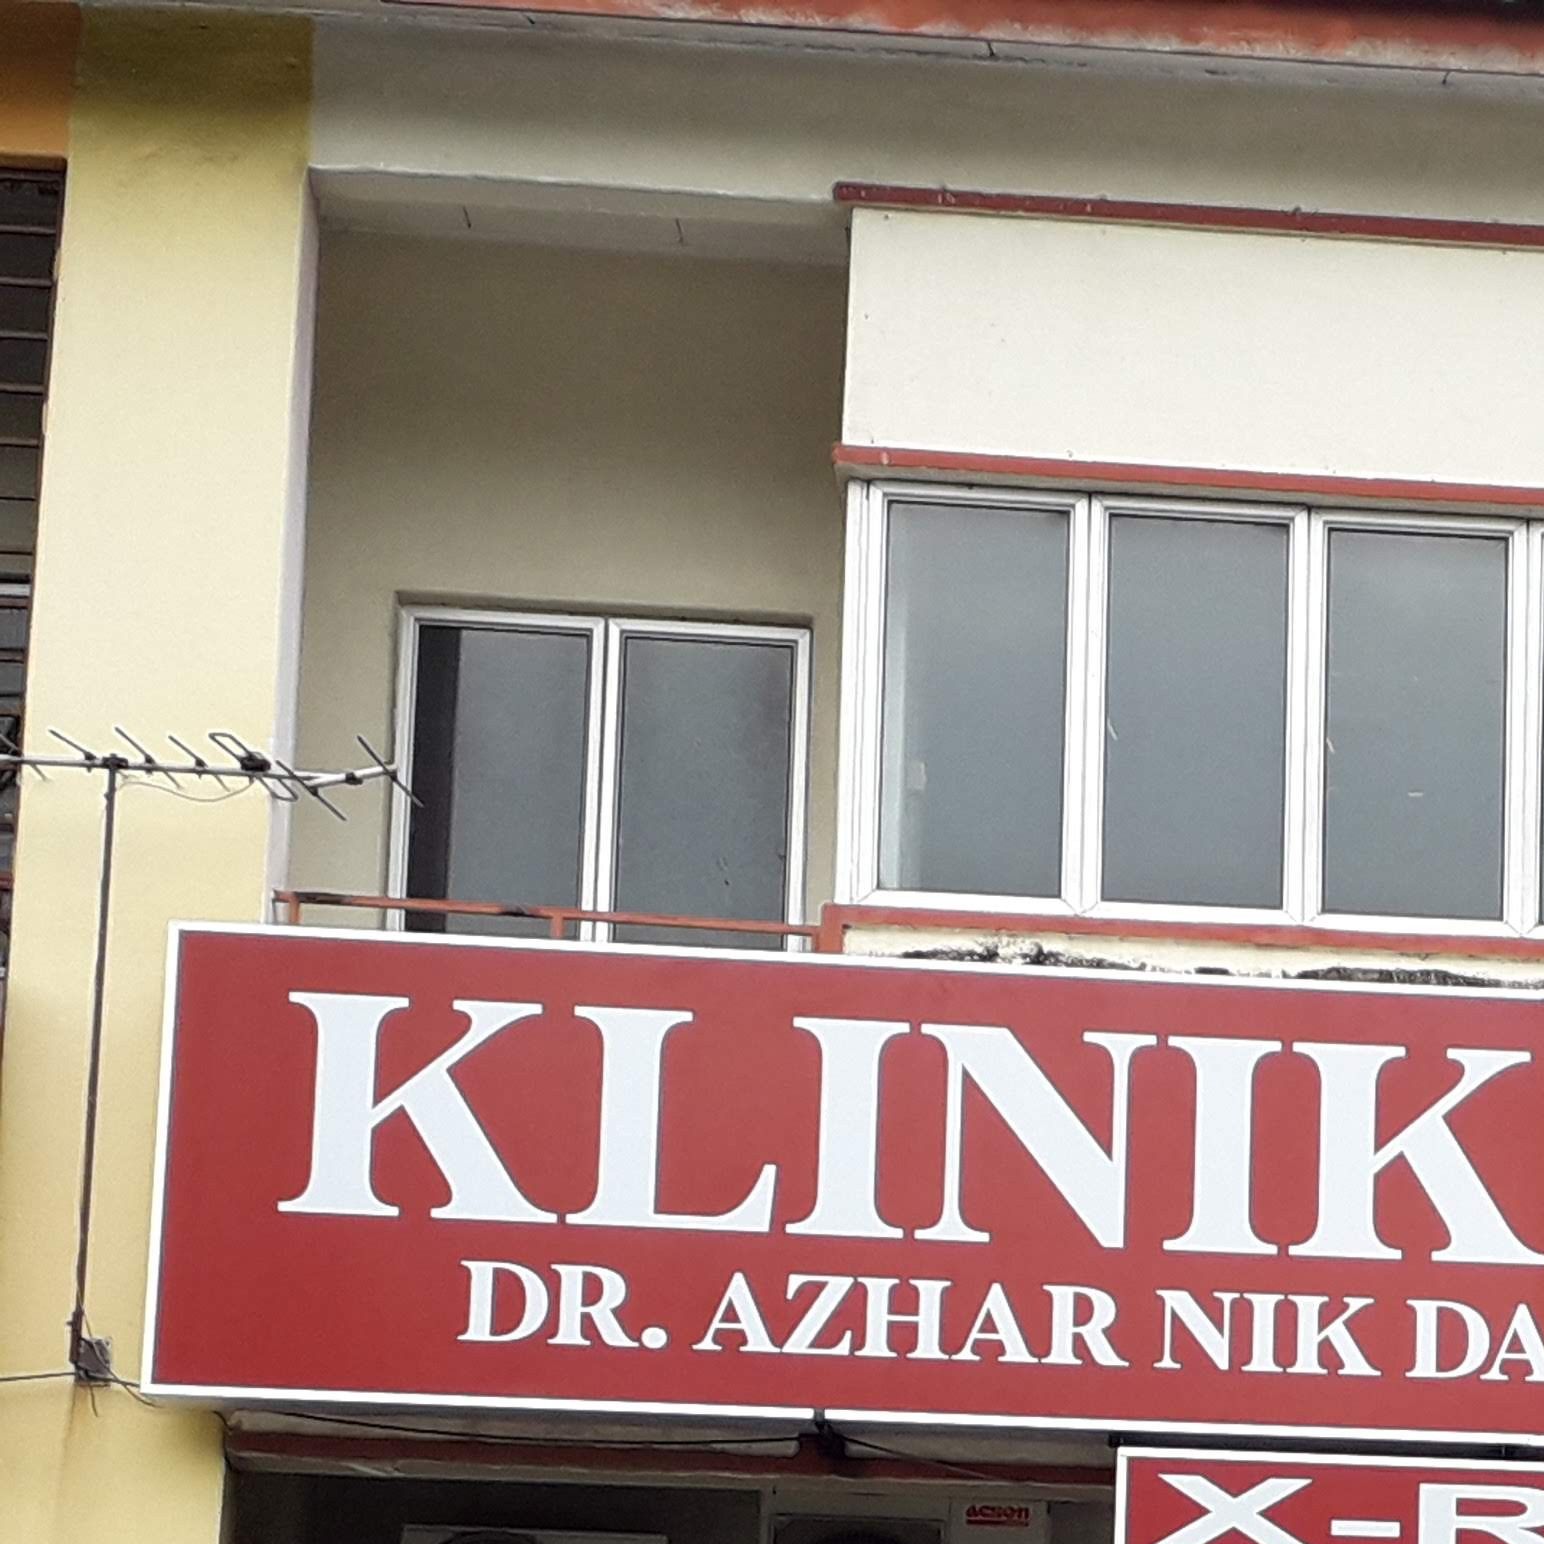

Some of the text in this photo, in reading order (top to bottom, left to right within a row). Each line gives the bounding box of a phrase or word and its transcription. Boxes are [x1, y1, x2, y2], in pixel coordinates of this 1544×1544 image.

[457, 1261, 668, 1349] DR.
[693, 1272, 1130, 1367] AZHAR
[1154, 1290, 1381, 1377] NIK
